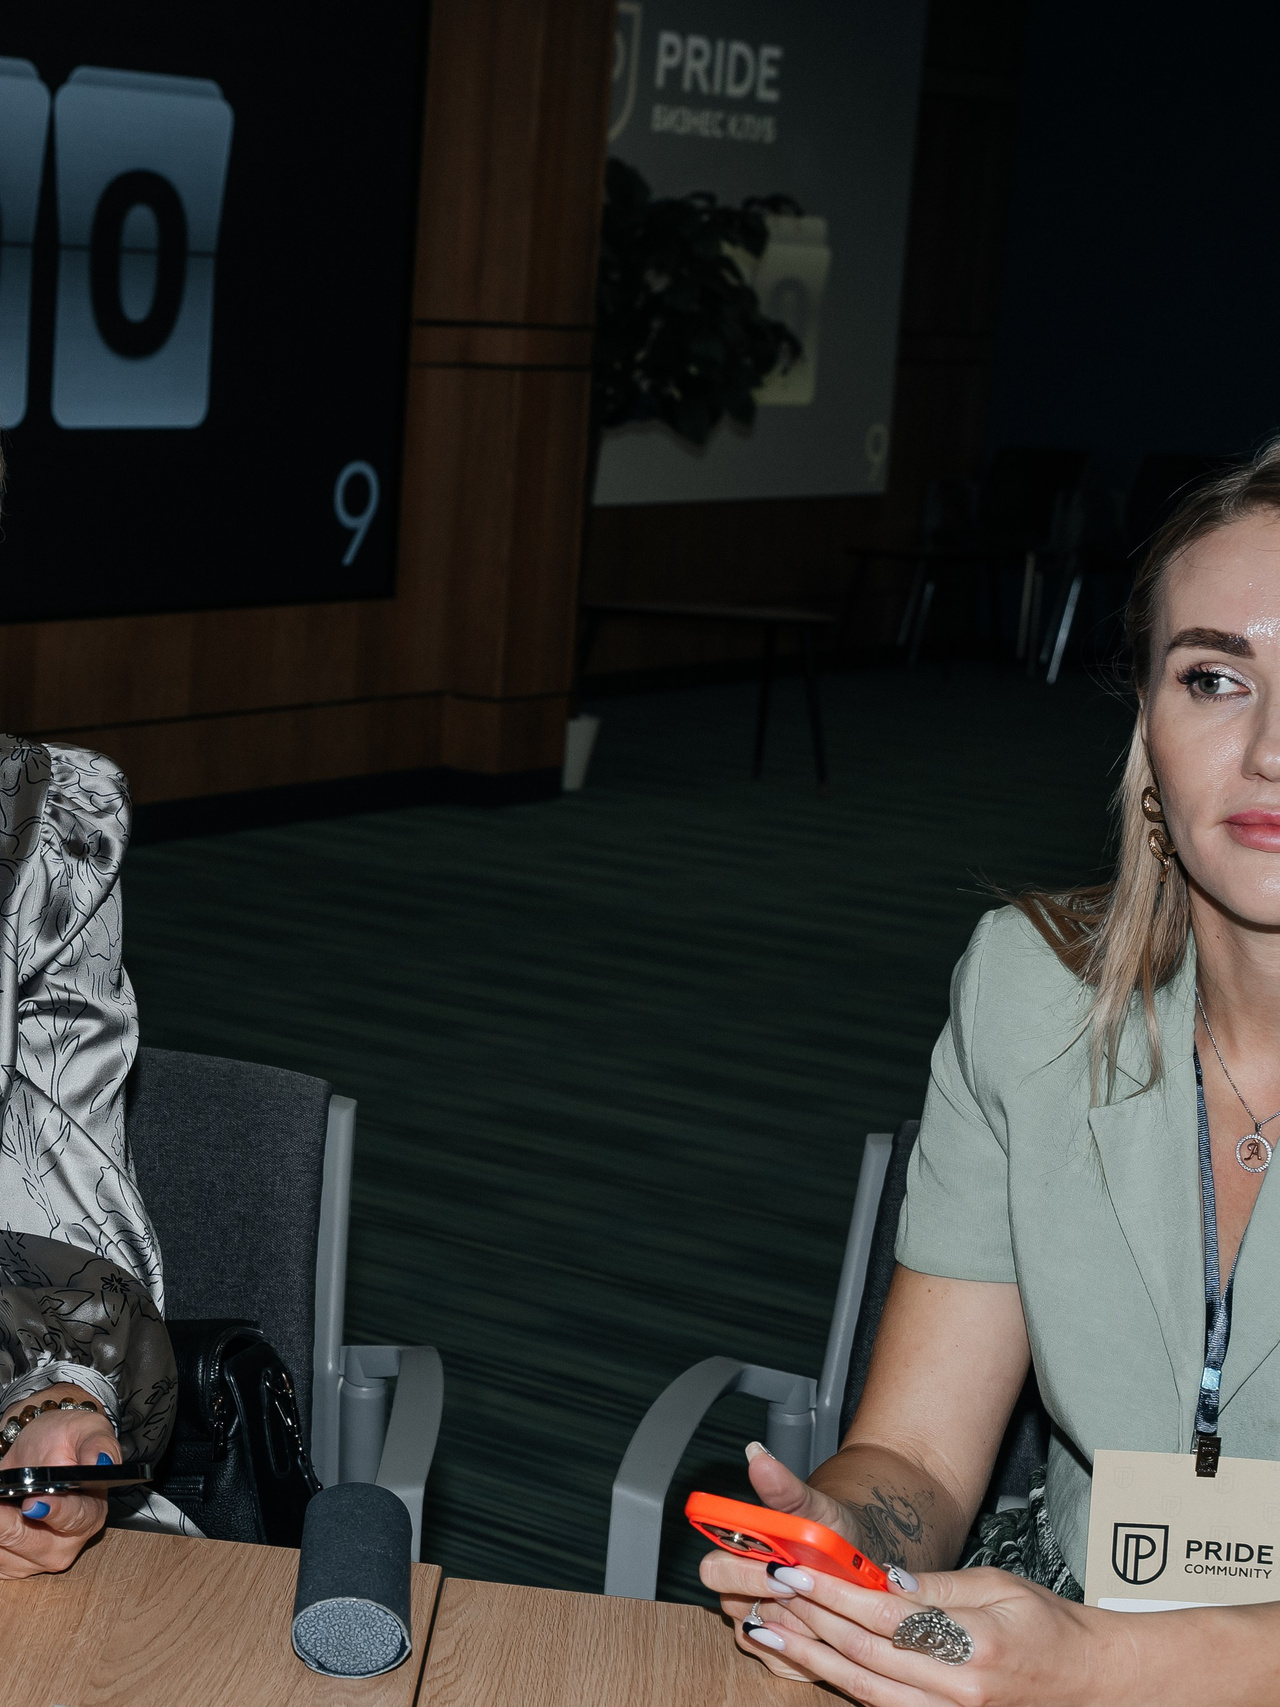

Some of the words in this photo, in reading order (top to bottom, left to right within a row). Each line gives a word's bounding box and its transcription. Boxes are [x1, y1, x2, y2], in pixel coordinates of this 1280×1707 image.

[654, 30, 783, 102] PRIDE
[333, 460, 381, 567] 9
[1184, 1564, 1272, 1579] COMMUNITY
[1185, 1540, 1274, 1565] PRIDE
